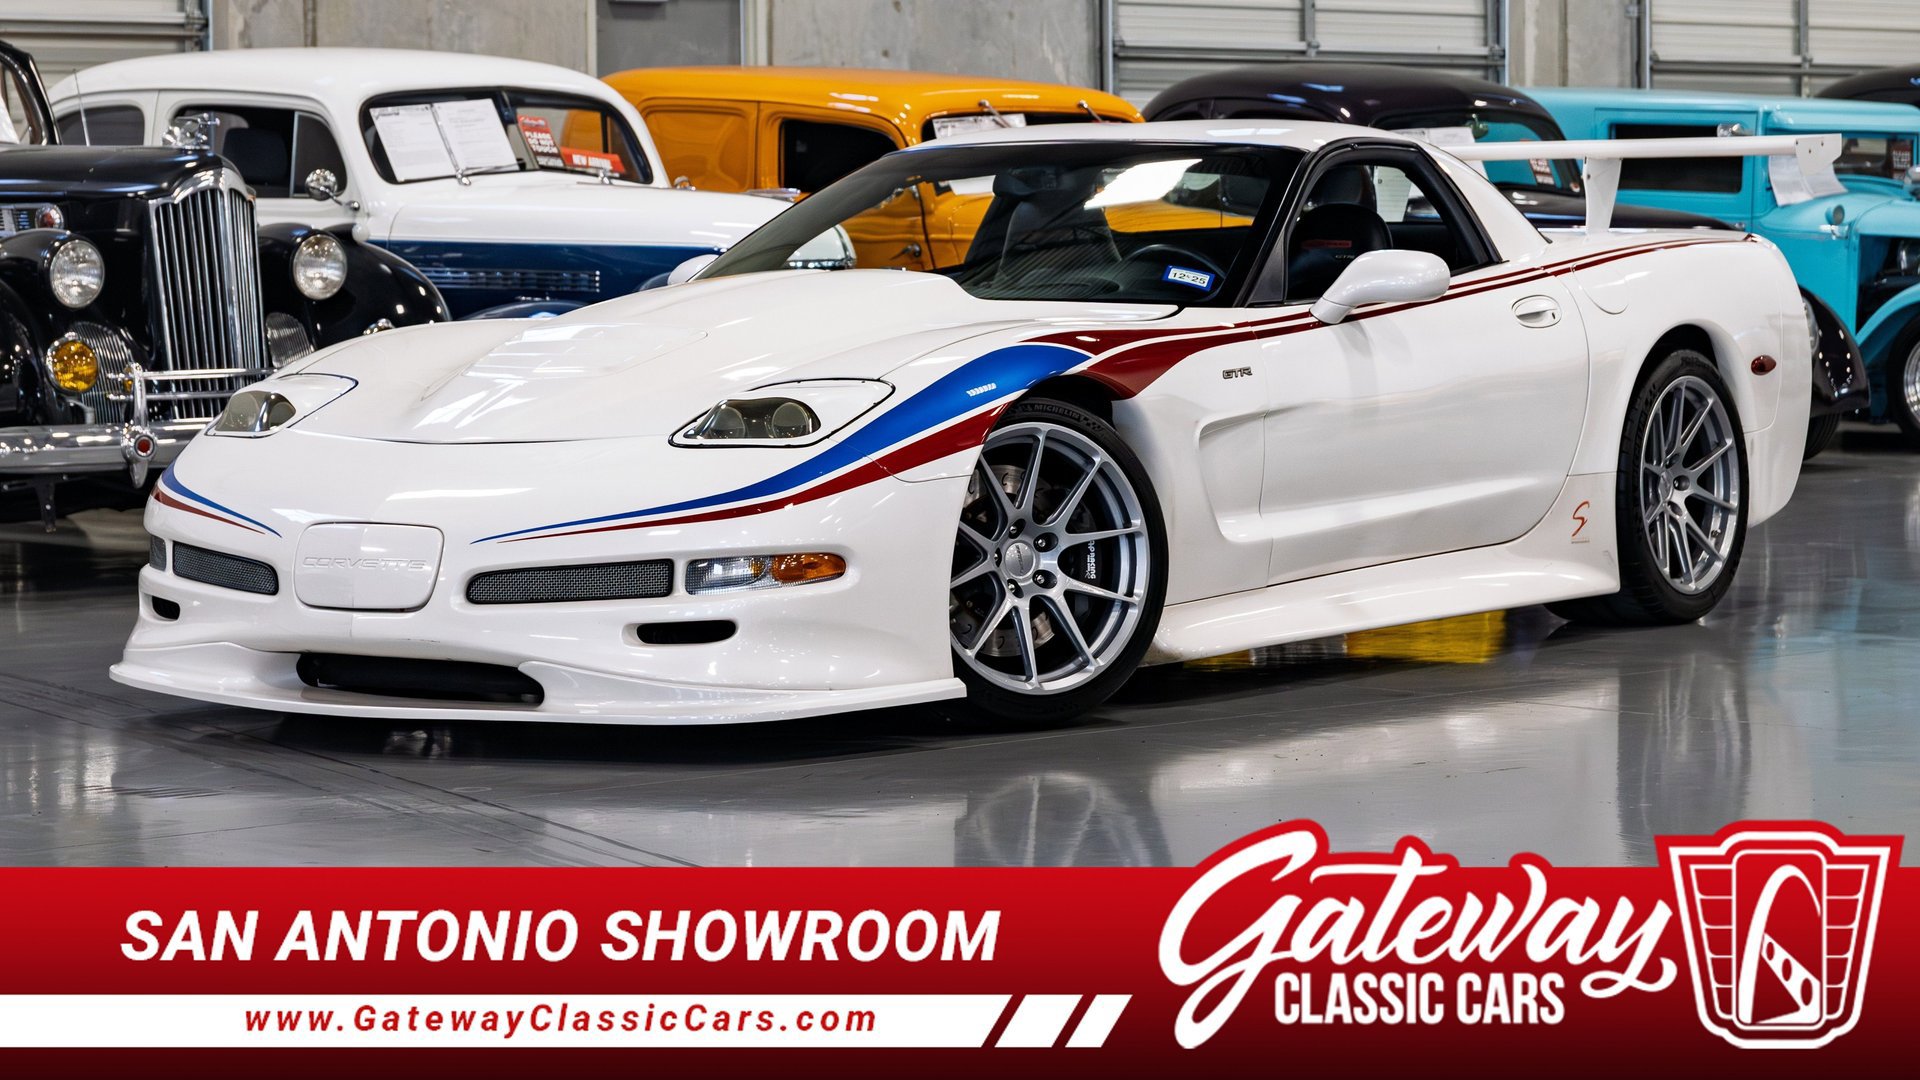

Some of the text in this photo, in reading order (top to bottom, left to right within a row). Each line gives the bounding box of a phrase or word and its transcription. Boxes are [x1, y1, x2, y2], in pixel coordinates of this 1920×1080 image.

[1223, 366, 1253, 379] GTR
[1034, 404, 1081, 419] MICHELIN
[302, 556, 428, 570] CORVETTE
